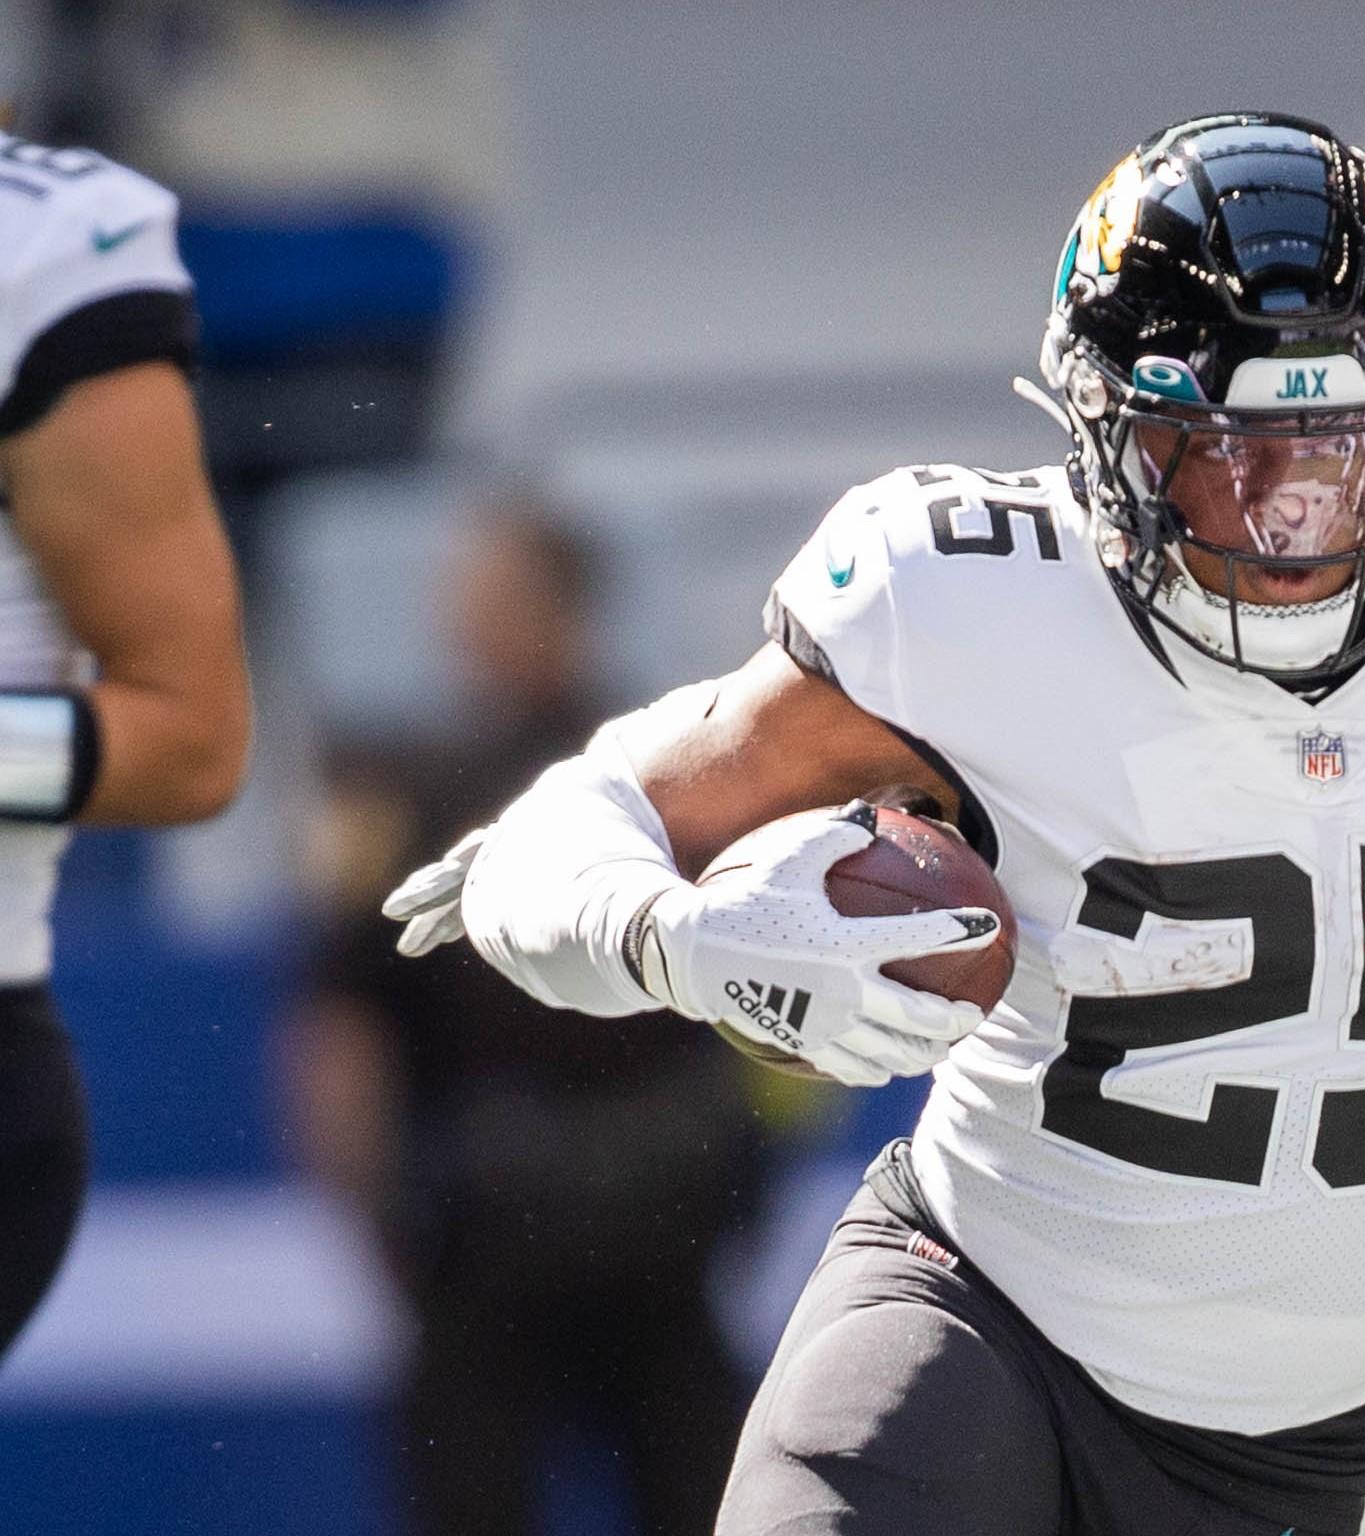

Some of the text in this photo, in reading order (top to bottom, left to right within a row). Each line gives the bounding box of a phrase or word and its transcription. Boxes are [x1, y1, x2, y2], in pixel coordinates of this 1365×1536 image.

[1276, 367, 1328, 398] JAX
[1307, 753, 1342, 778] NFL
[724, 980, 804, 1049] adidas
